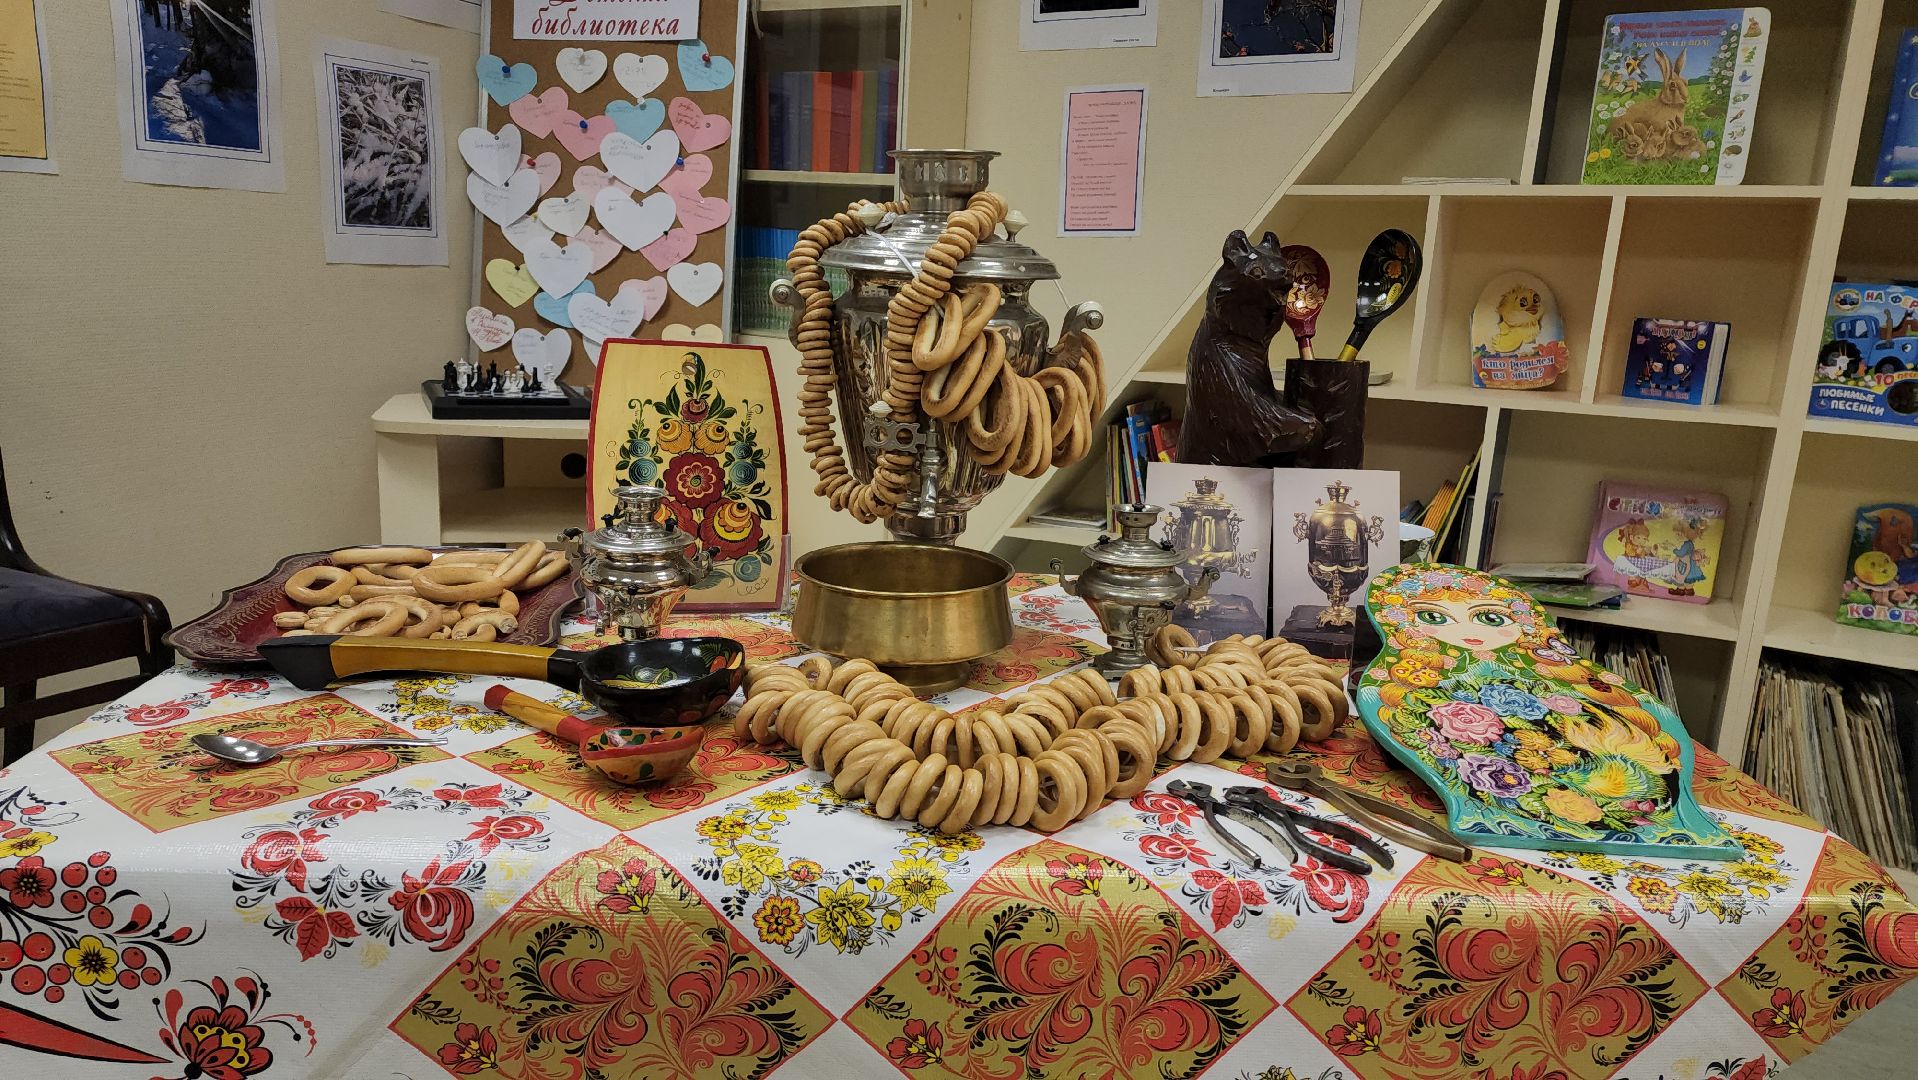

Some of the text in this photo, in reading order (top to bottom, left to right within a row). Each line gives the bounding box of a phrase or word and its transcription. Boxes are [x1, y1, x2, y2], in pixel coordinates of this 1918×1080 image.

[531, 6, 680, 36] библиотека
[1865, 291, 1883, 302] НА
[1482, 359, 1506, 369] Кто
[1874, 374, 1894, 386] 10
[1819, 388, 1875, 402] ЛЮБИМЫЕ
[1830, 400, 1885, 416] ПЕСЕНКИ
[1848, 603, 1918, 626] КОЛОБ
